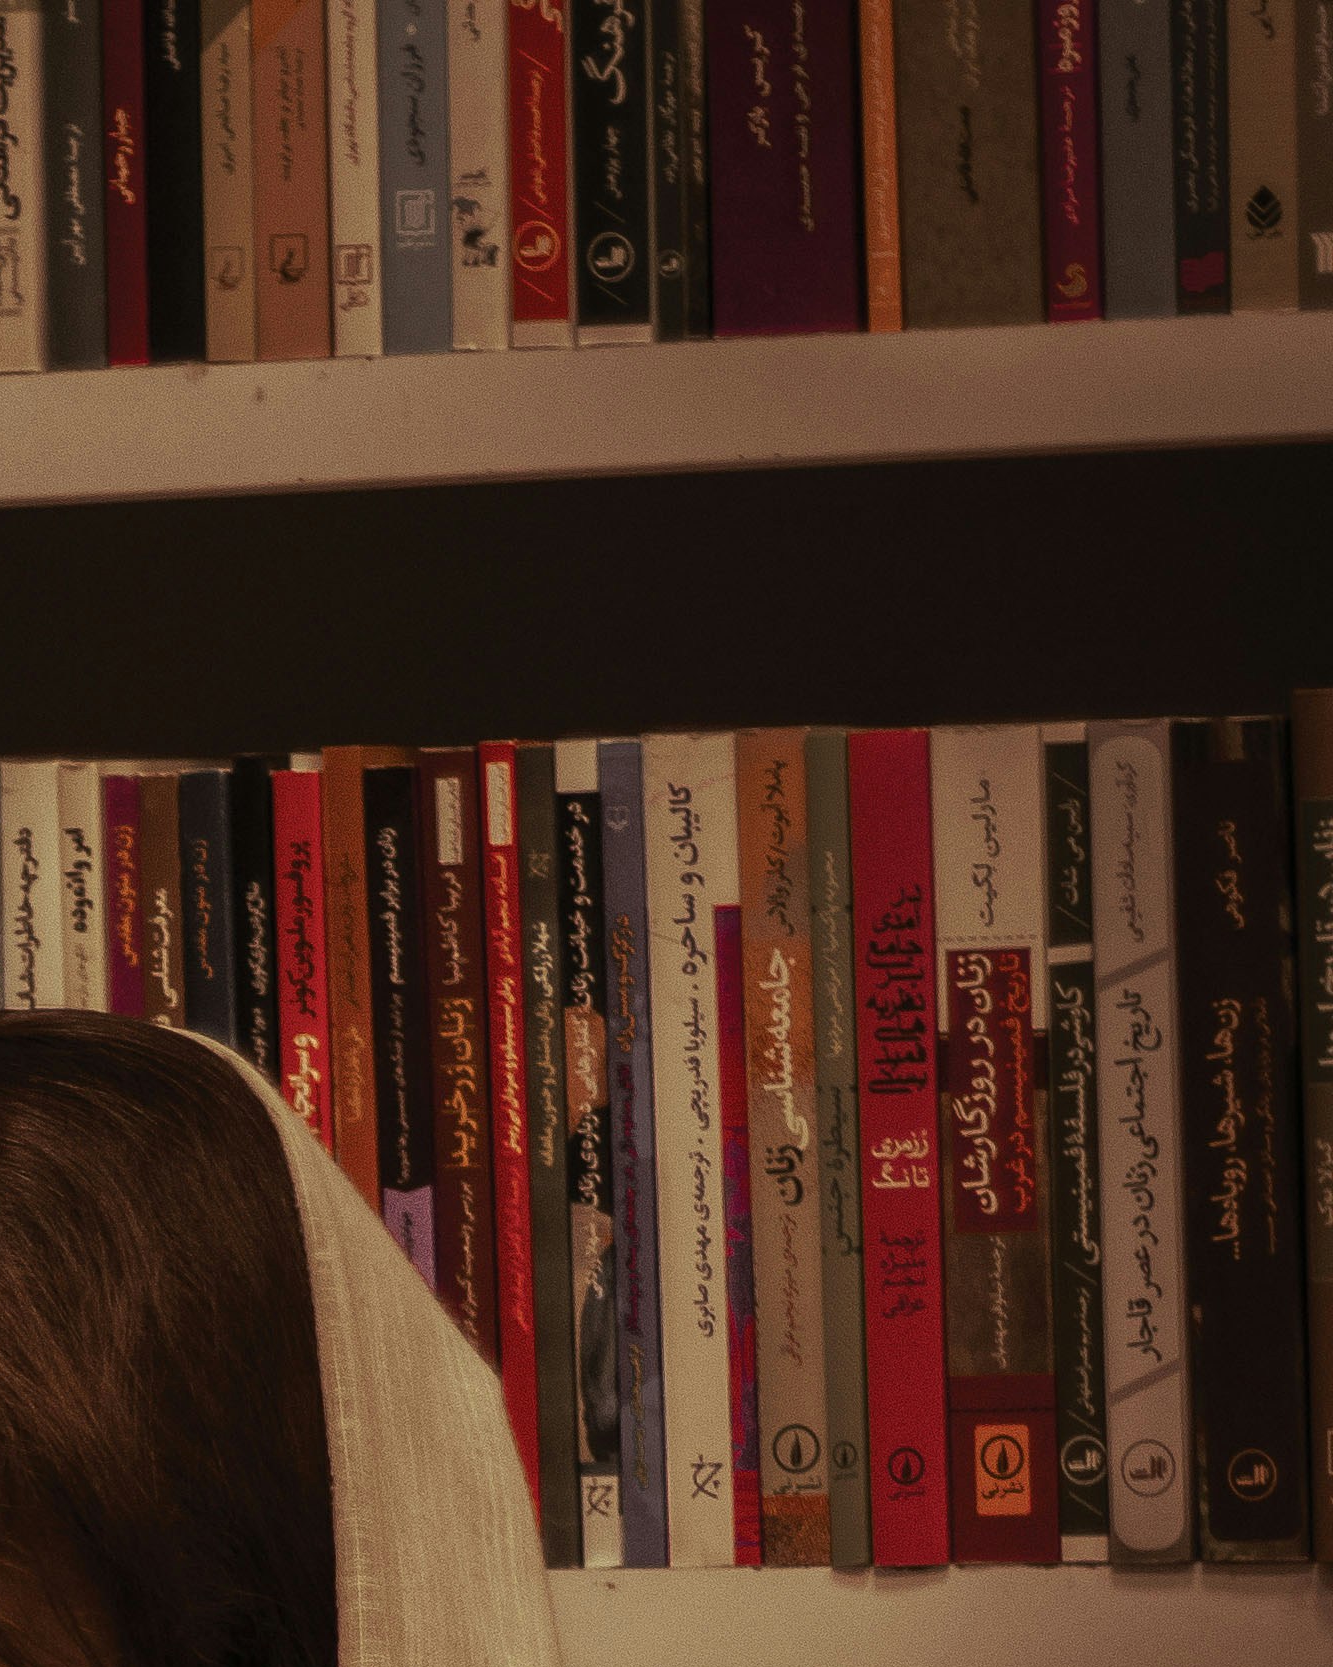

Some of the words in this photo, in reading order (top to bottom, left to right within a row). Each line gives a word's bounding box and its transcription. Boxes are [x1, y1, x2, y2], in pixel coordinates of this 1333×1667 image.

[667, 781, 699, 865] کالیبان
[971, 778, 1000, 856] مارلین
[568, 824, 591, 890] خدمت
[677, 870, 705, 884] و
[669, 892, 708, 975] ساحره
[953, 951, 996, 1013] زنان
[999, 952, 1030, 1013] تاریخ
[963, 1014, 990, 1055] در
[1120, 987, 1160, 1051] تاریخ
[1003, 1015, 1033, 1127] فمینیسم
[952, 1057, 997, 1214] روزگارشان
[1114, 1056, 1159, 1158] اجتماعی
[765, 1143, 803, 1205] زنان
[1064, 1143, 1102, 1264] فمینیستی
[1125, 1161, 1159, 1210] زنان
[688, 1225, 712, 1279] مهدی
[1133, 1213, 1159, 1239] در
[1136, 1243, 1162, 1296] عصر
[1123, 1297, 1162, 1362] قاجار
